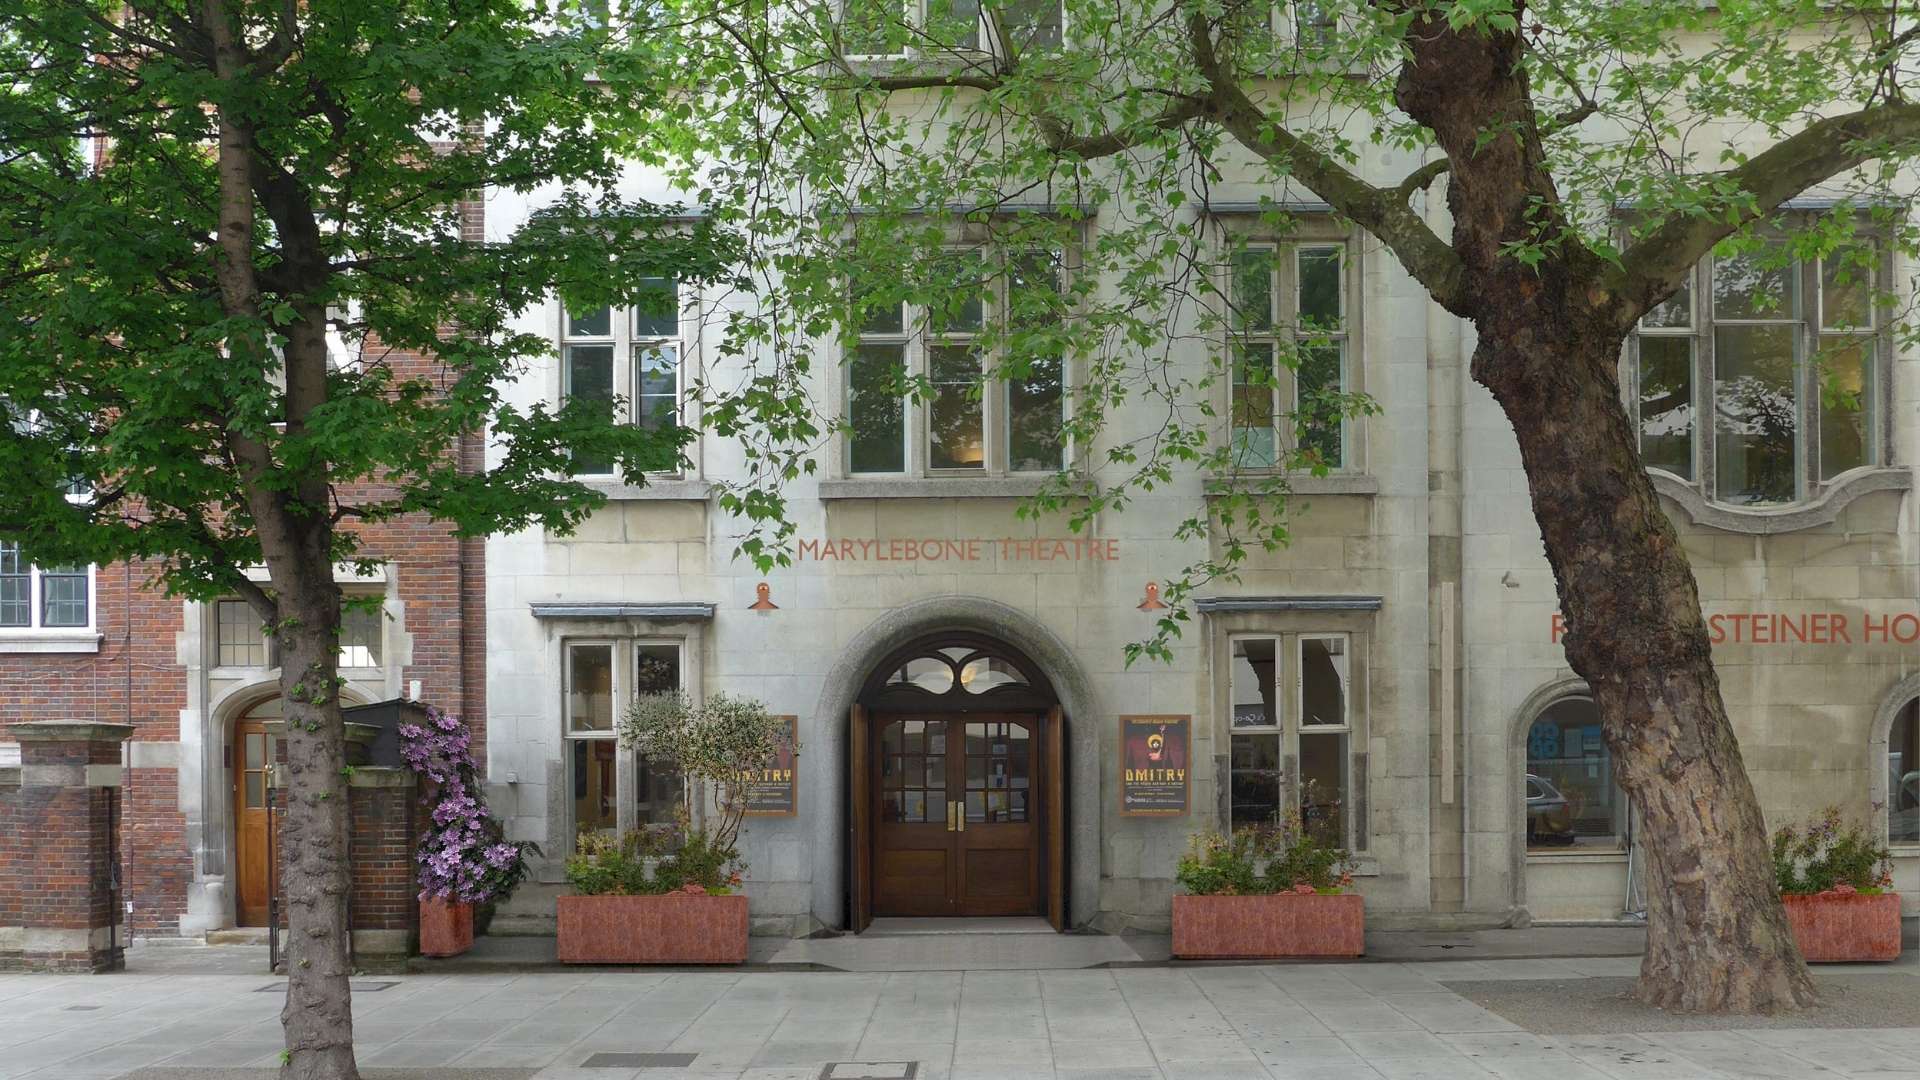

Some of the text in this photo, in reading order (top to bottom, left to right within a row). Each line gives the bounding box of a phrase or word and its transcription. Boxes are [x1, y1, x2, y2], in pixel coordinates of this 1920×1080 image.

[798, 539, 1120, 560] MARYLEBONE THEATRE
[1709, 613, 1852, 644] STEINER
[1125, 768, 1185, 781] DMITRY
